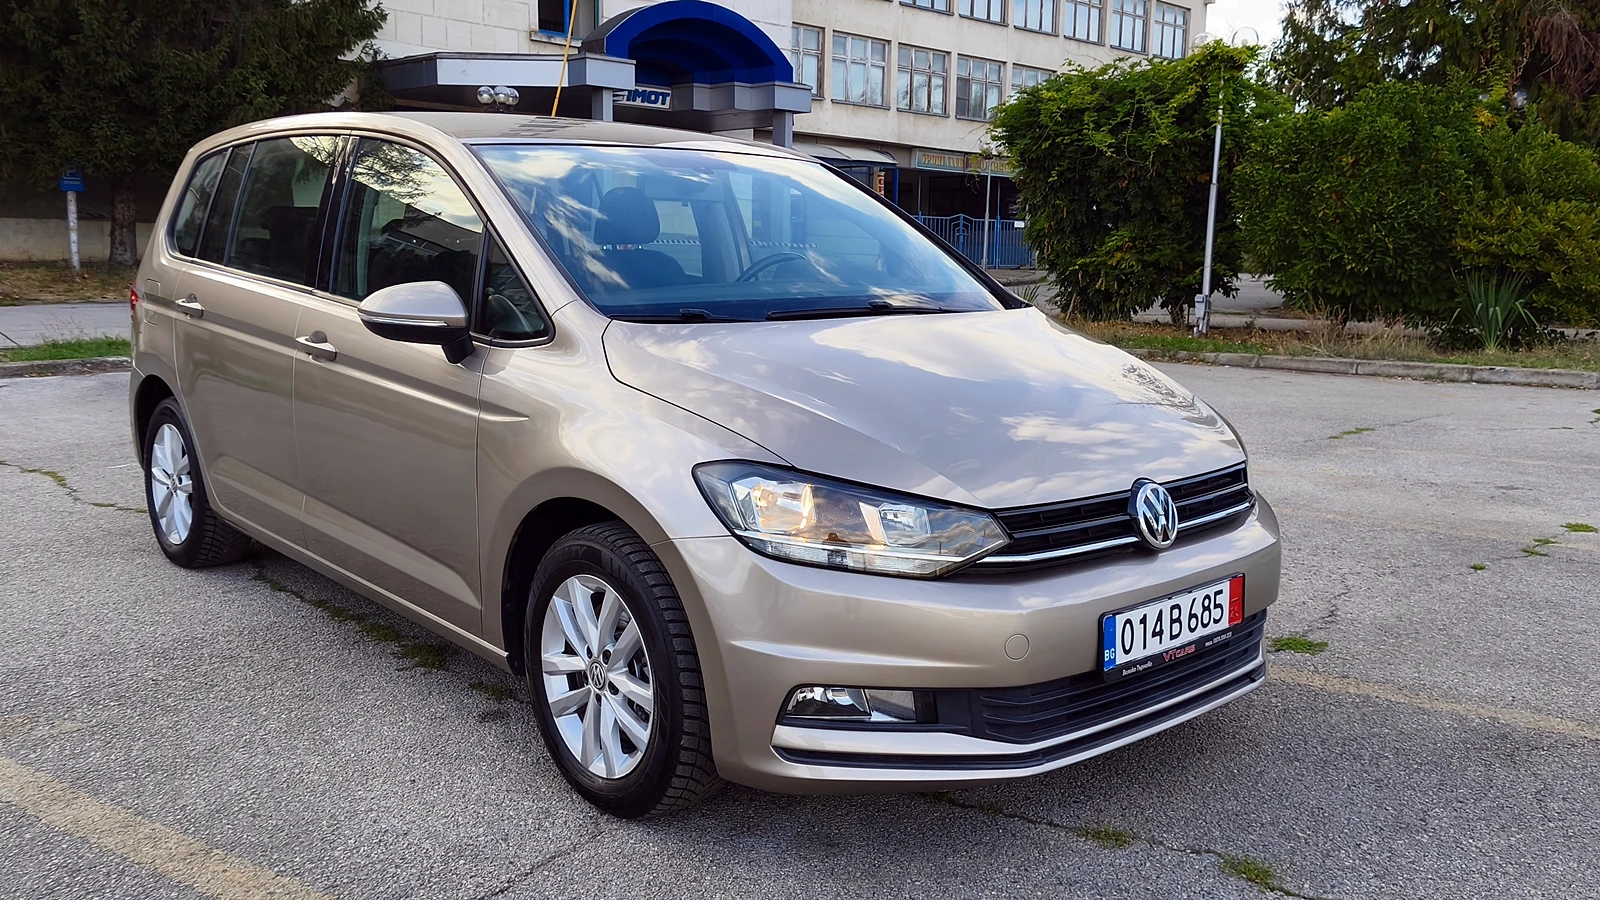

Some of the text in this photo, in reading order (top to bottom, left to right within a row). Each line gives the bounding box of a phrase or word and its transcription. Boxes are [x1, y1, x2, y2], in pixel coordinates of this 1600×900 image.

[921, 153, 964, 168] SPORT CLUB
[1104, 648, 1115, 661] BG
